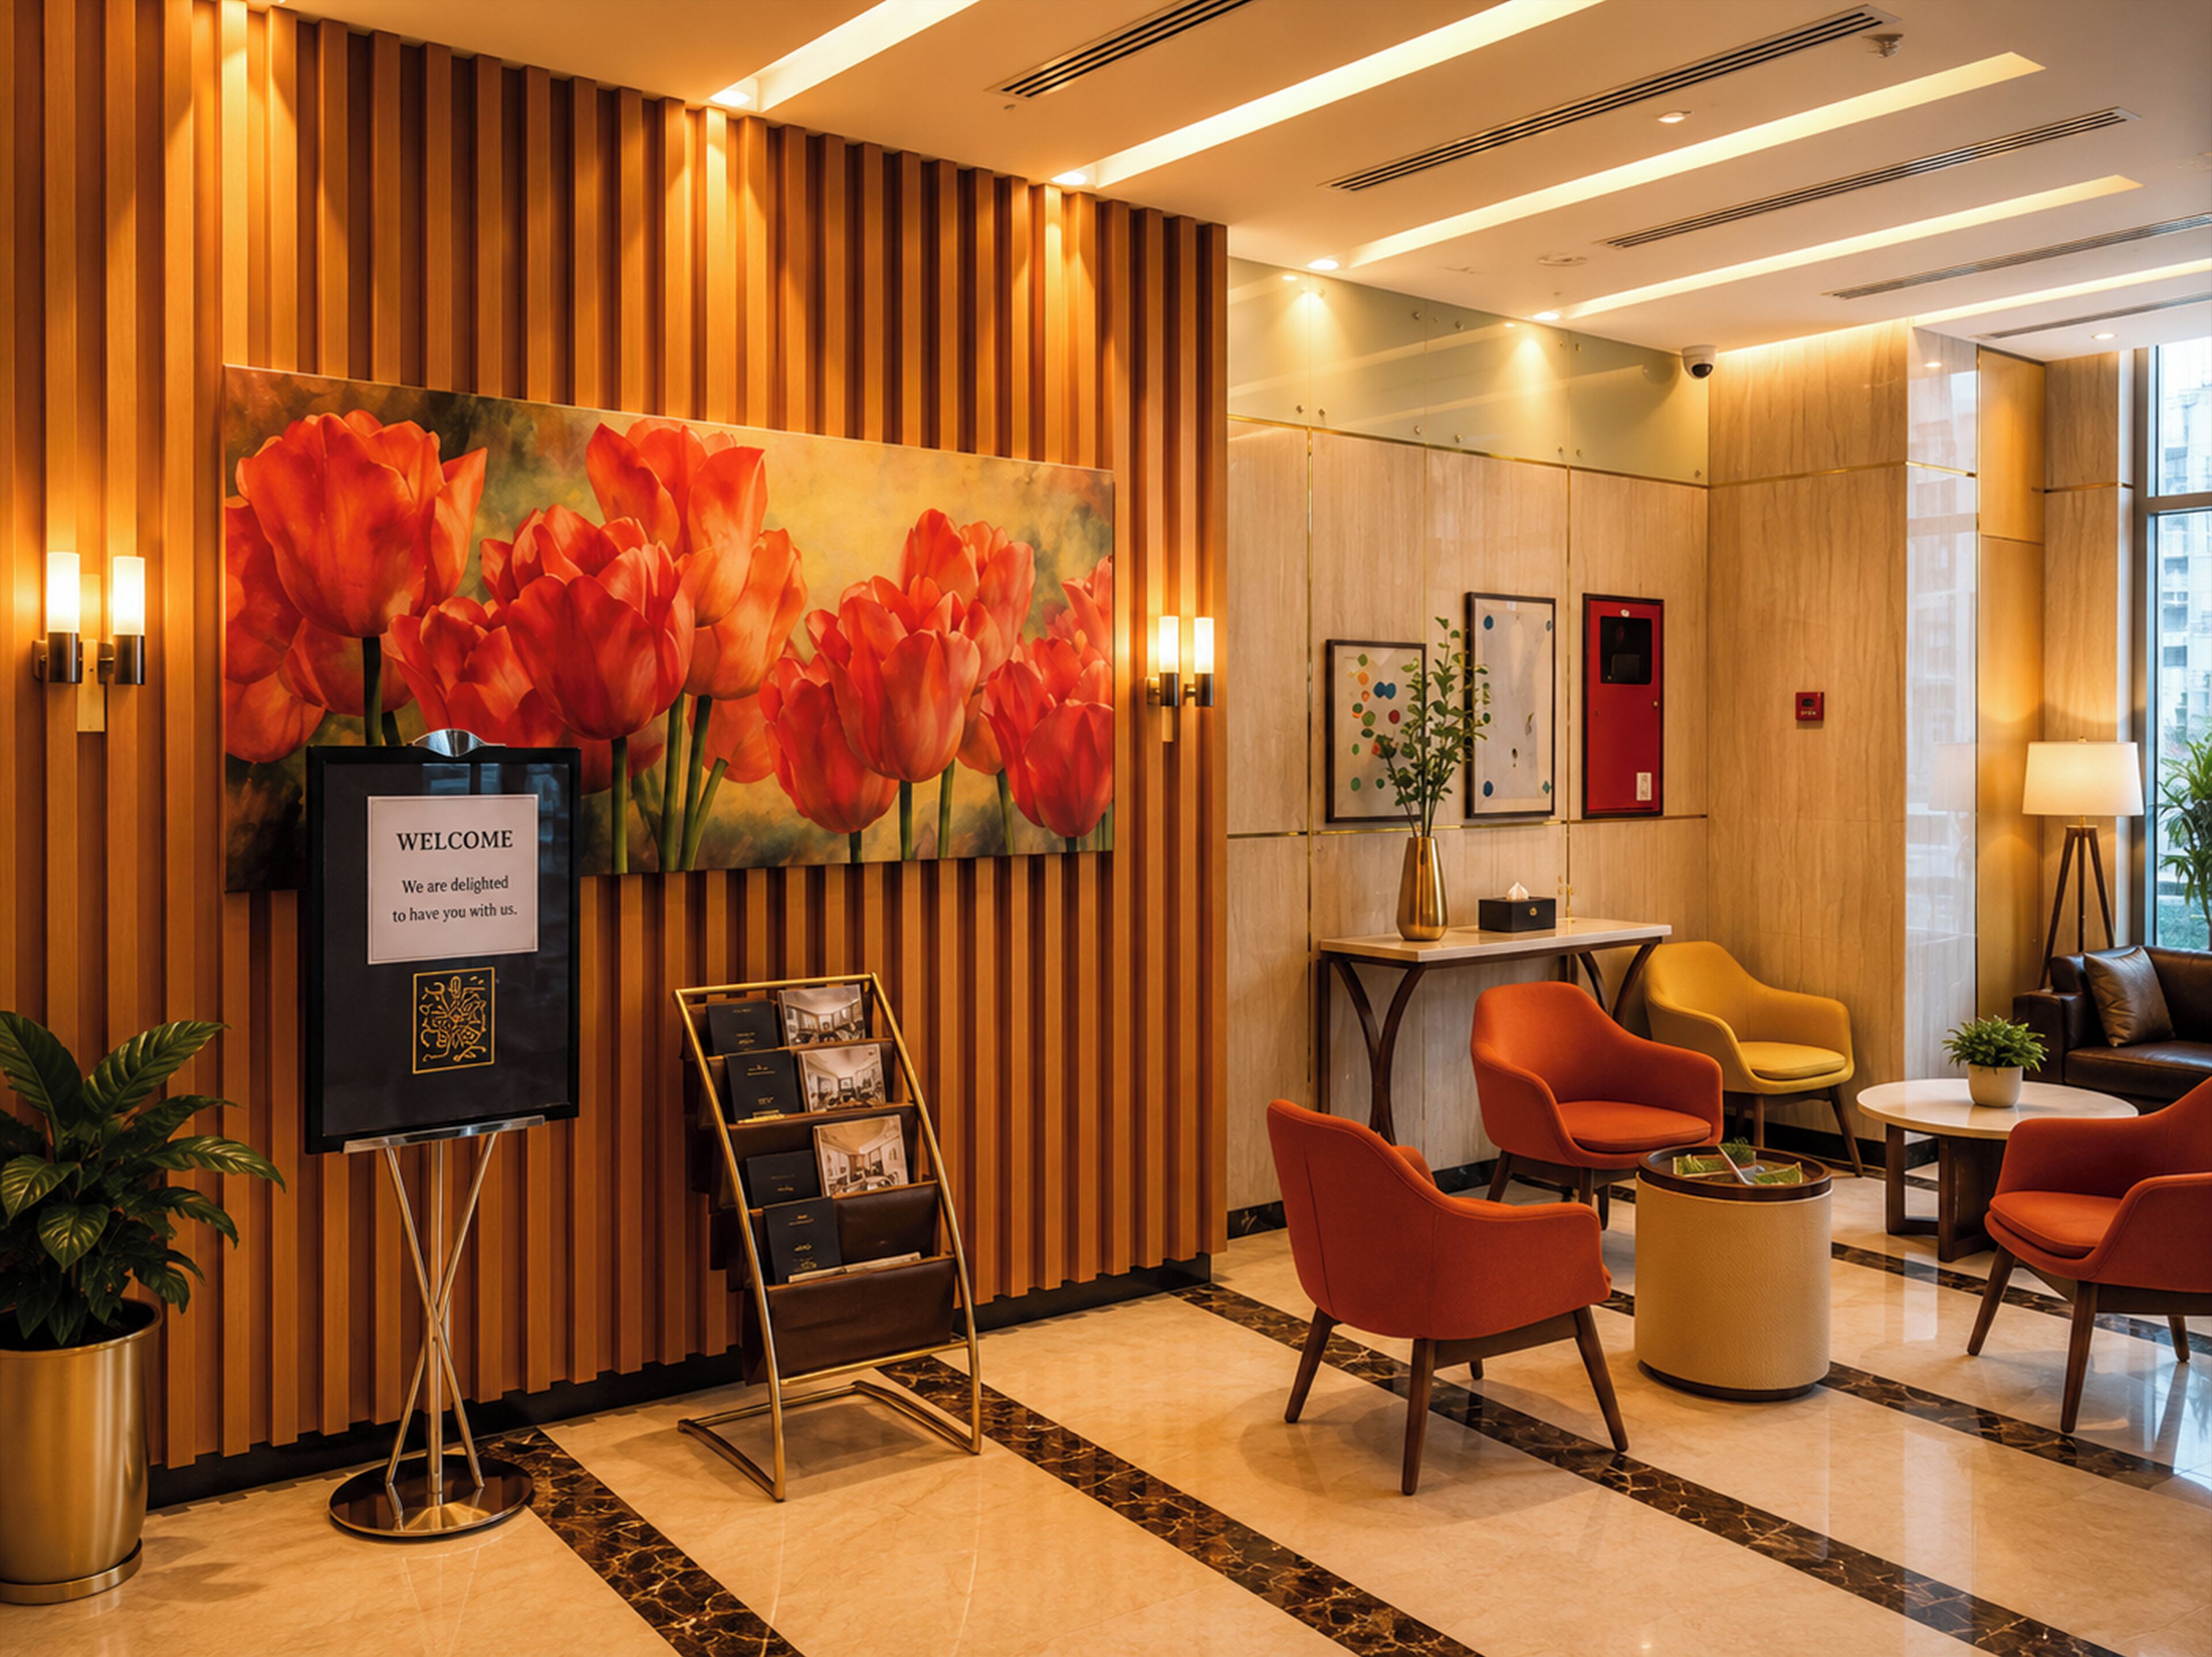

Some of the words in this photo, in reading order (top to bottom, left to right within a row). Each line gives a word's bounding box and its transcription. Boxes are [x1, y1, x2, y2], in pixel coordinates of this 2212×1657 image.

[396, 830, 513, 851] WELCOME
[402, 880, 423, 893] We
[427, 881, 447, 893] are
[450, 875, 509, 894] delighted
[392, 911, 406, 922] to
[410, 907, 439, 921] have
[443, 908, 466, 922] you
[469, 903, 497, 917] with
[501, 905, 517, 915] us.
